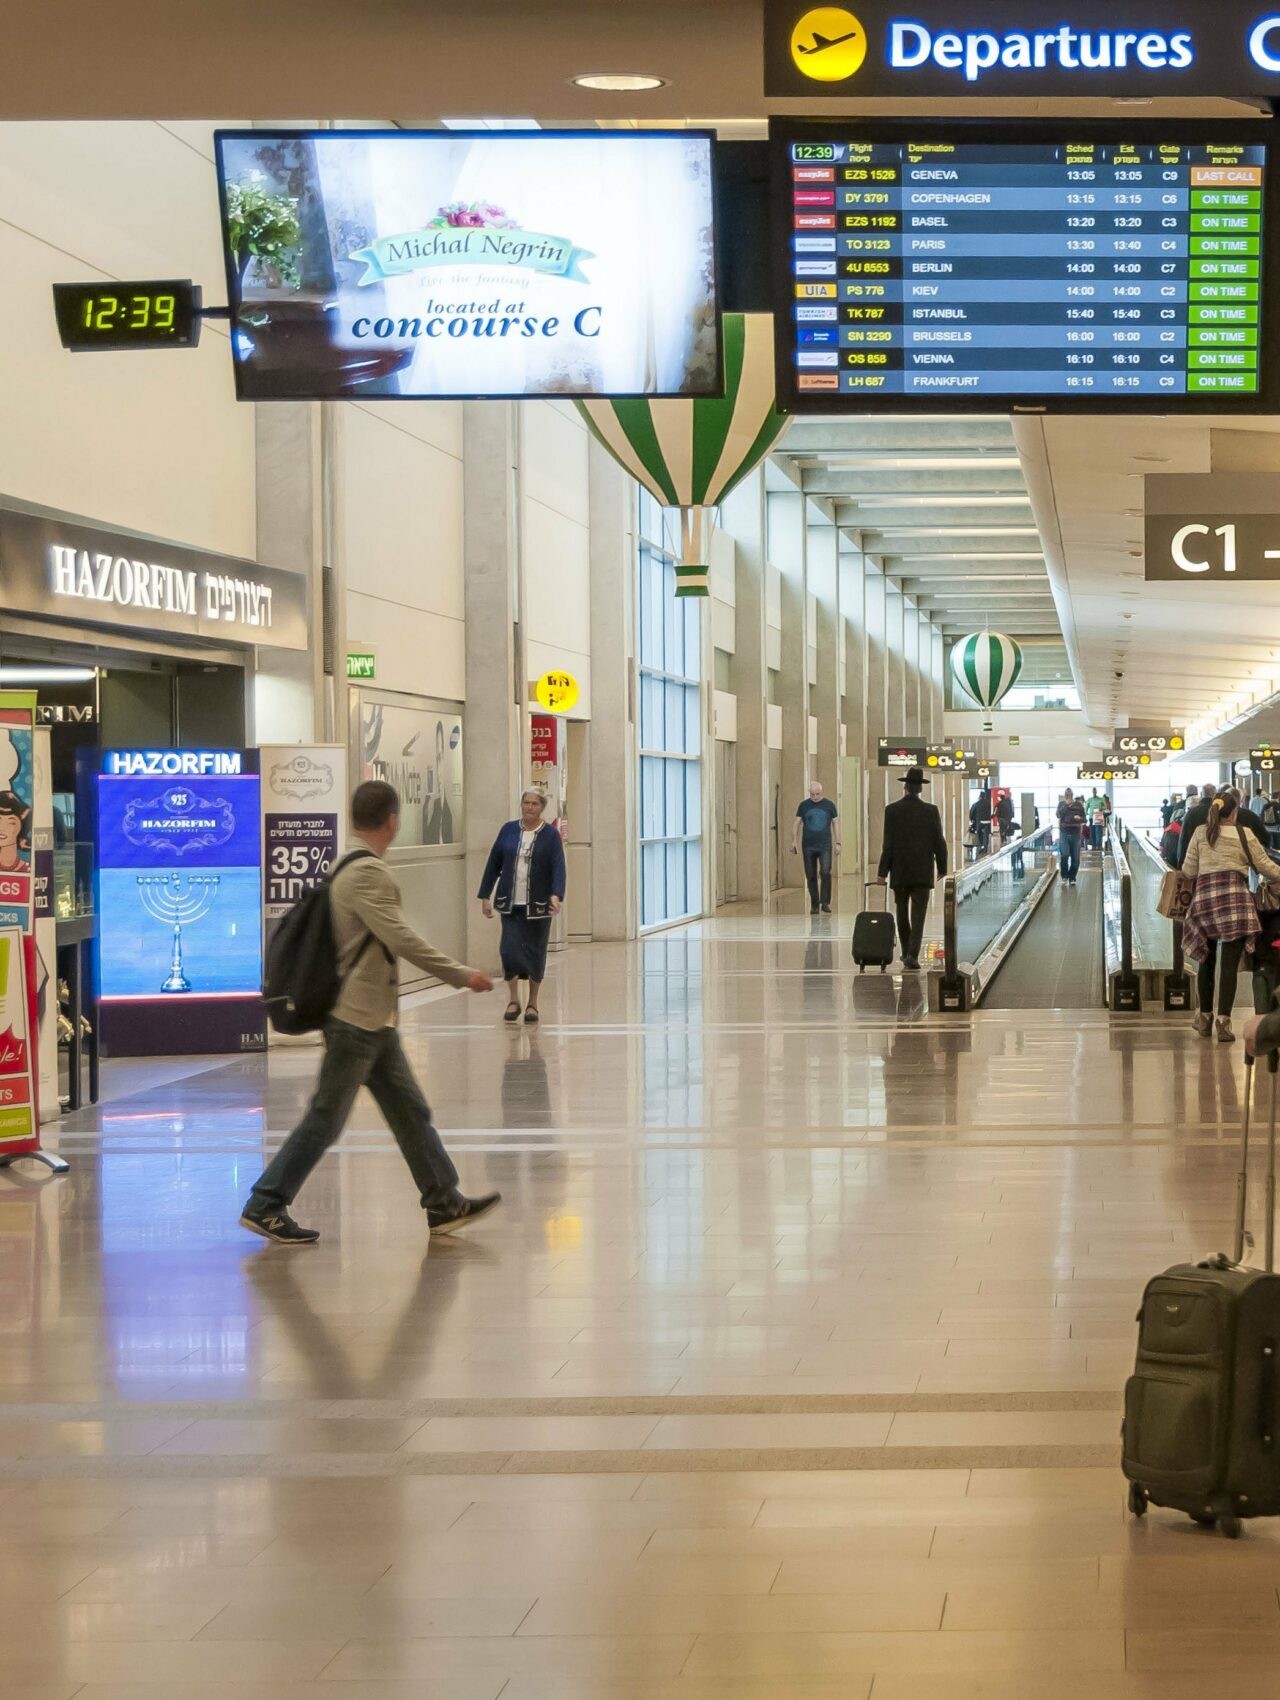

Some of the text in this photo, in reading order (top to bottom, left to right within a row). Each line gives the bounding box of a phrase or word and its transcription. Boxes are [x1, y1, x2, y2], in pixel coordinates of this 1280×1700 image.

[891, 22, 1193, 81] Departures
[796, 146, 833, 159] 12:39
[849, 144, 873, 154] Flight
[908, 144, 955, 152] Destination
[1066, 145, 1094, 153] Sched
[1119, 145, 1135, 153] Est
[1159, 145, 1180, 153] Gate
[1206, 145, 1244, 154] Remarks
[845, 171, 867, 180] EZS
[871, 171, 896, 180] 1526
[911, 171, 958, 180] GENEVA
[1066, 171, 1095, 180] 13:05
[1114, 171, 1142, 180] 13:05
[1162, 171, 1178, 180] C9
[1197, 172, 1223, 181] LAST
[1230, 172, 1256, 181] CALL
[845, 194, 1248, 204] DY 3791 COPENHAGEN 13:15 13:15 C6 ON TIME
[846, 217, 869, 226] EZS
[871, 217, 896, 226] 1192
[912, 217, 949, 226] BASEL
[1066, 218, 1095, 226] 13:20
[1113, 218, 1142, 226] 13:20
[1161, 218, 1177, 226] C3
[1202, 218, 1219, 227] ON
[1222, 218, 1248, 227] TIME
[387, 231, 564, 265] Michal Negrin
[846, 263, 1247, 274] 4U 8553 BERLIN 14:00 14:00 C7 ON TIME
[805, 286, 827, 295] UIA
[85, 296, 175, 329] 12:39
[427, 299, 526, 315] located at
[847, 309, 1246, 319] TK 787 ISTANBUL 15:40 15:40 C3 ON TIME
[351, 306, 603, 338] concourse C
[1171, 523, 1236, 573] C1
[52, 545, 198, 616] HAZORFIM
[205, 571, 273, 628] הצורפים
[1120, 737, 1138, 750] C6
[1148, 737, 1166, 750] C9
[113, 753, 241, 775] HAZORFIM
[1260, 759, 1274, 769] C3
[170, 794, 187, 806] 925
[142, 819, 216, 828] HAZORFIM
[271, 846, 330, 876] 35%
